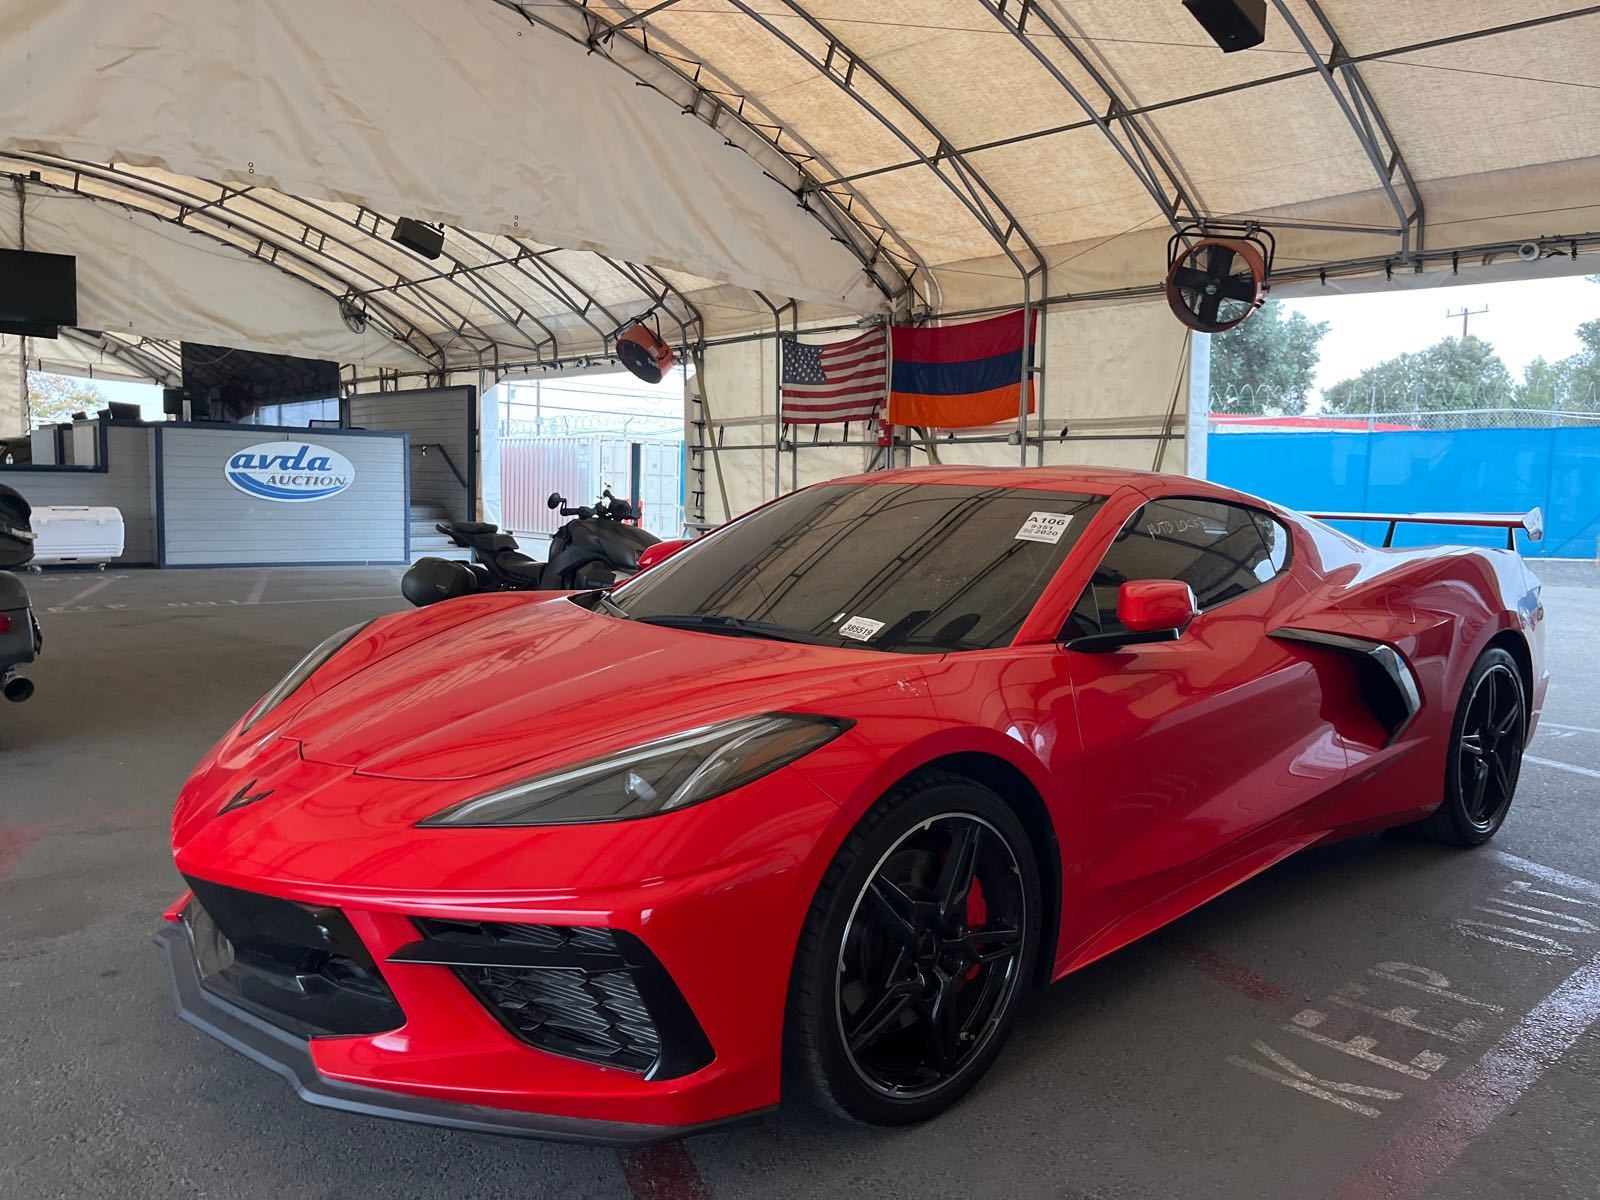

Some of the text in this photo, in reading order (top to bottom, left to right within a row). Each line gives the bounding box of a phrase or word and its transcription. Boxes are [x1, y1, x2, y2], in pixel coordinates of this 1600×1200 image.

[230, 446, 333, 472] avda
[264, 475, 346, 486] AUCTION
[1028, 516, 1066, 526] A106
[844, 624, 874, 637] 385519
[1224, 961, 1504, 1119] KEEP
